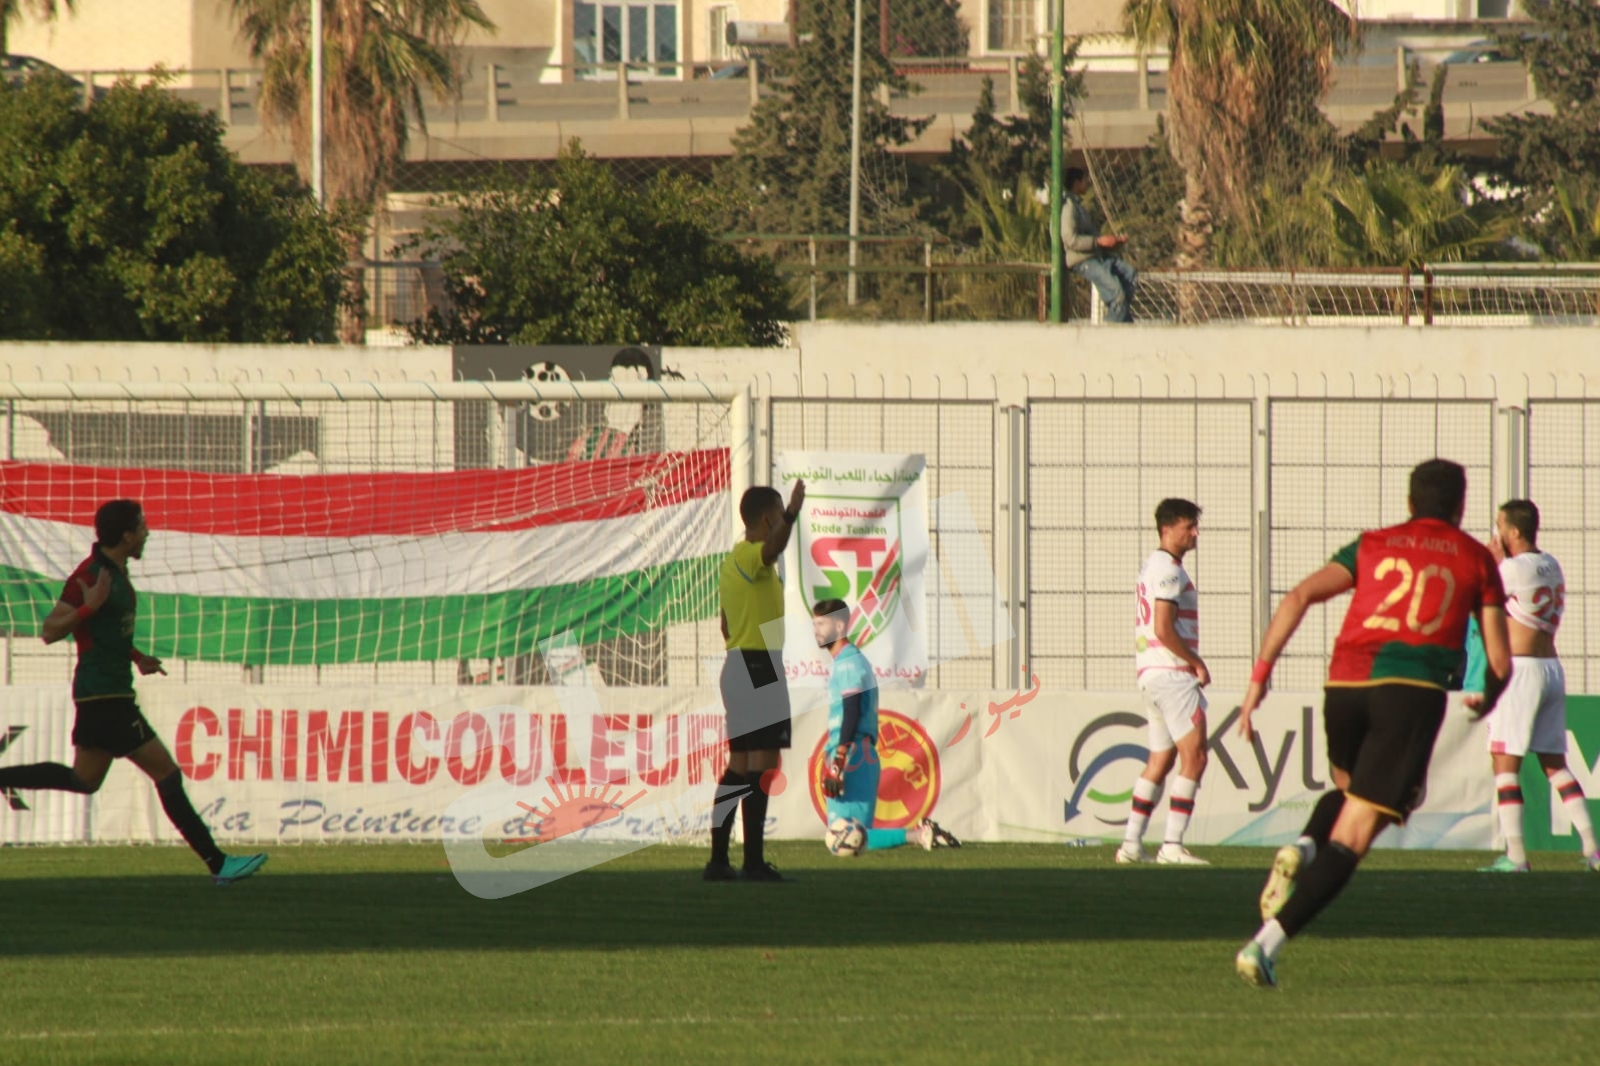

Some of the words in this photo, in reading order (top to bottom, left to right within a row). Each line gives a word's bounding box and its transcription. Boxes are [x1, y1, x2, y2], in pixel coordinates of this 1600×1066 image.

[810, 522, 842, 535] Stade
[1363, 557, 1455, 636] 20
[175, 705, 784, 786] CHIMICOULEUR
[278, 799, 481, 837] Peinture
[503, 798, 556, 837] de
